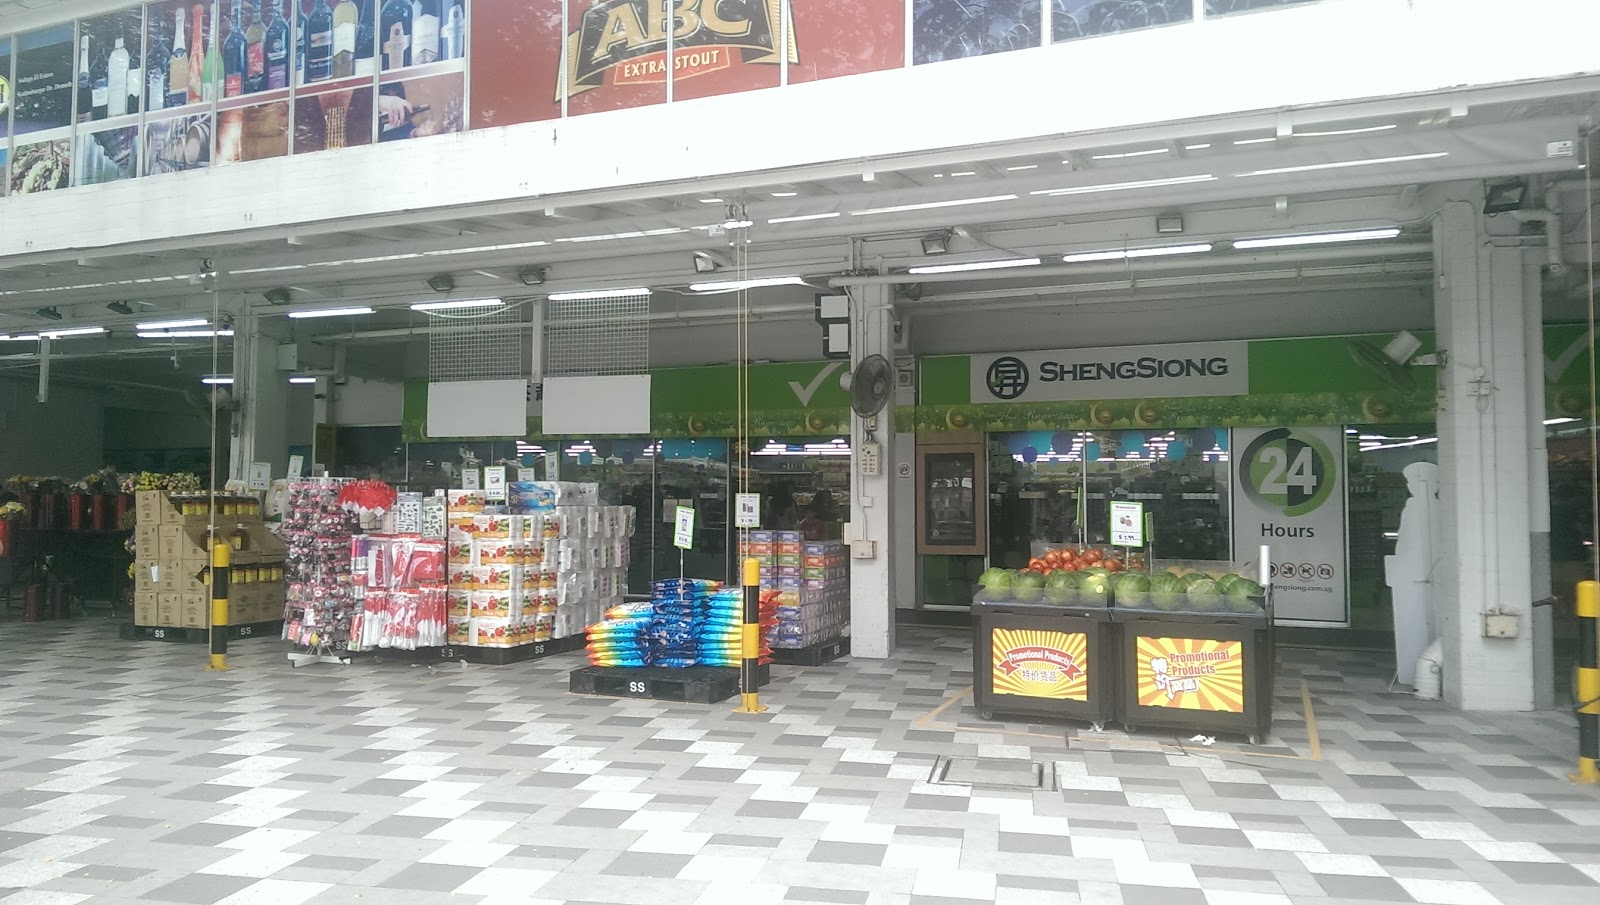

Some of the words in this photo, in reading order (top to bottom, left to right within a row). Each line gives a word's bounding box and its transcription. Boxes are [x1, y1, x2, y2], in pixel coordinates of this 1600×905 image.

[591, 0, 752, 64] ABC
[624, 56, 667, 78] EXTRA
[674, 50, 720, 70] STOUT
[1258, 446, 1318, 495] 24
[1261, 523, 1315, 538] Hours
[154, 630, 165, 639] SS
[240, 627, 252, 635] SS
[335, 641, 347, 650] SS
[534, 644, 545, 654] SS
[833, 644, 841, 655] SS
[1008, 649, 1044, 662] Promotional
[1045, 650, 1071, 666] Products
[1170, 650, 1230, 663] Promotional
[1022, 669, 1058, 682] 特价货品
[1172, 665, 1216, 676] Products
[629, 681, 646, 693] SS
